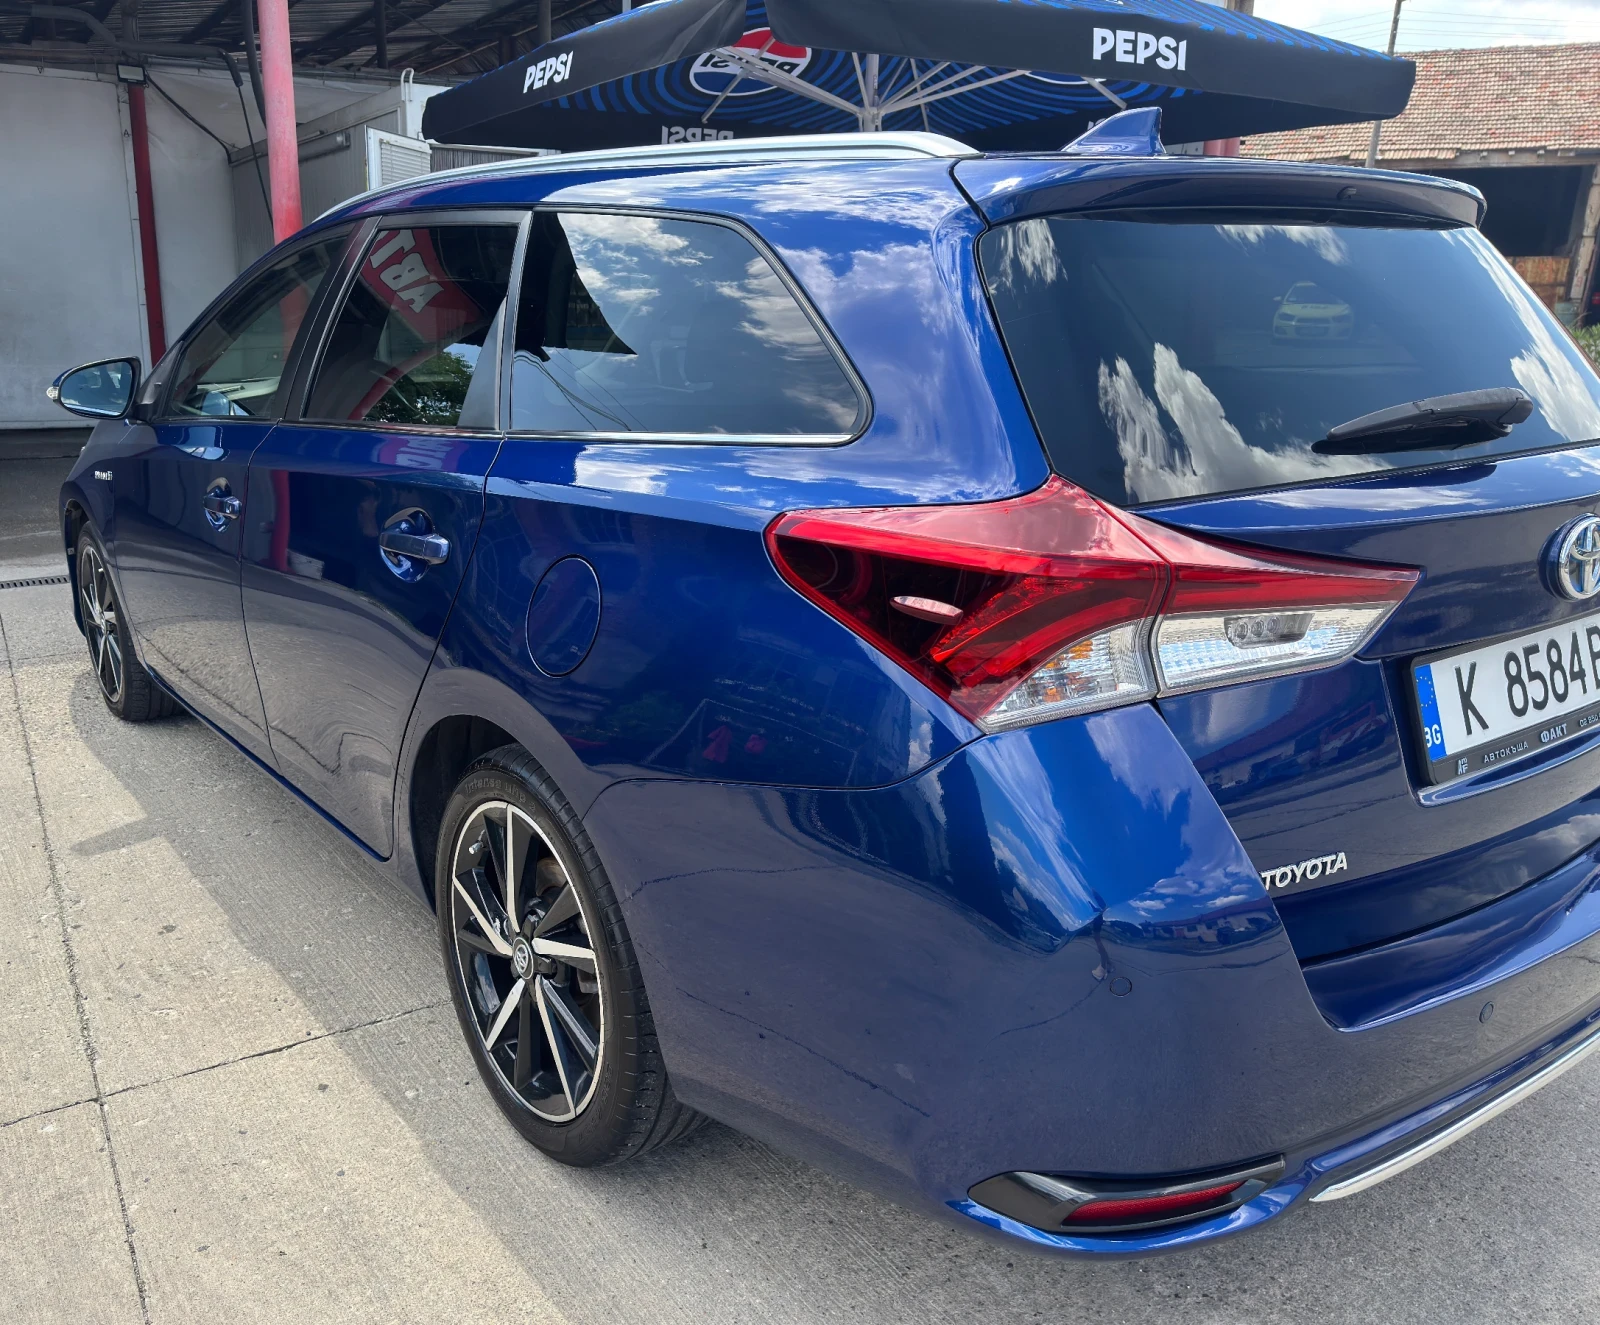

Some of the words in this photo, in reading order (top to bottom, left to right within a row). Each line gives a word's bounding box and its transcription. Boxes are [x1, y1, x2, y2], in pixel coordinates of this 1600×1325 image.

[1093, 28, 1187, 71] PEPSI
[523, 51, 574, 93] PEPSI
[1454, 661, 1489, 736] K
[1541, 723, 1567, 743] ФАКТ
[1260, 851, 1348, 891] TOYOTA
